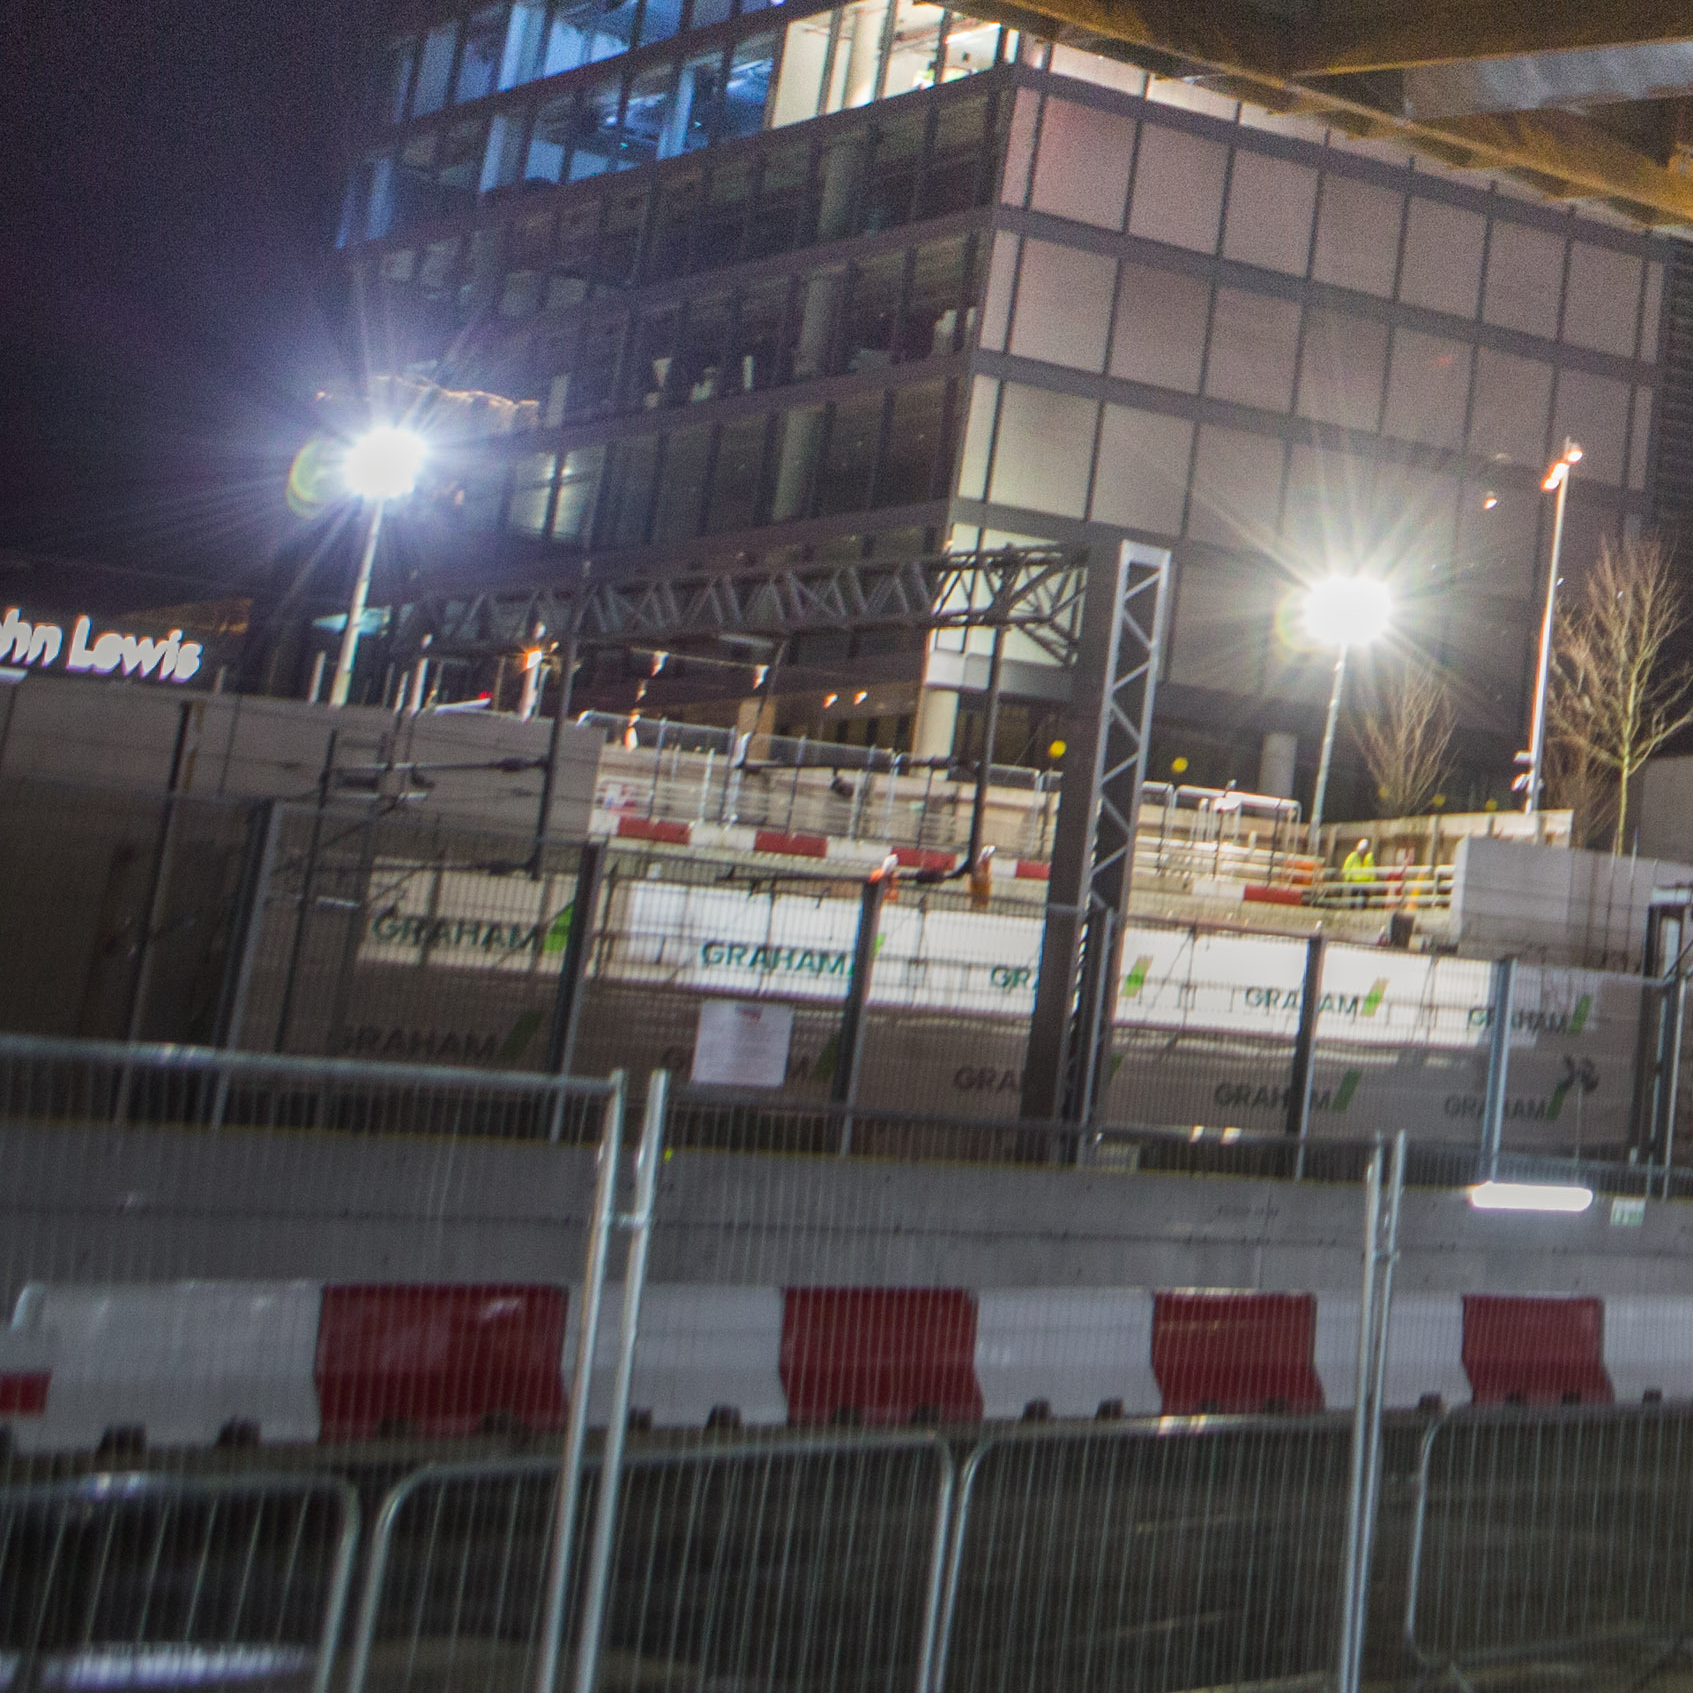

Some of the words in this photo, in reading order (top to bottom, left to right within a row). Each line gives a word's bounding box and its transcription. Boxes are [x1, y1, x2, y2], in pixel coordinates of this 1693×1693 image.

[66, 614, 204, 683] Lewis
[700, 941, 851, 976] GRAHAM
[1244, 987, 1360, 1014] GRAAM
[953, 1066, 1020, 1091] GRA
[1215, 1083, 1331, 1113] GRAHM
